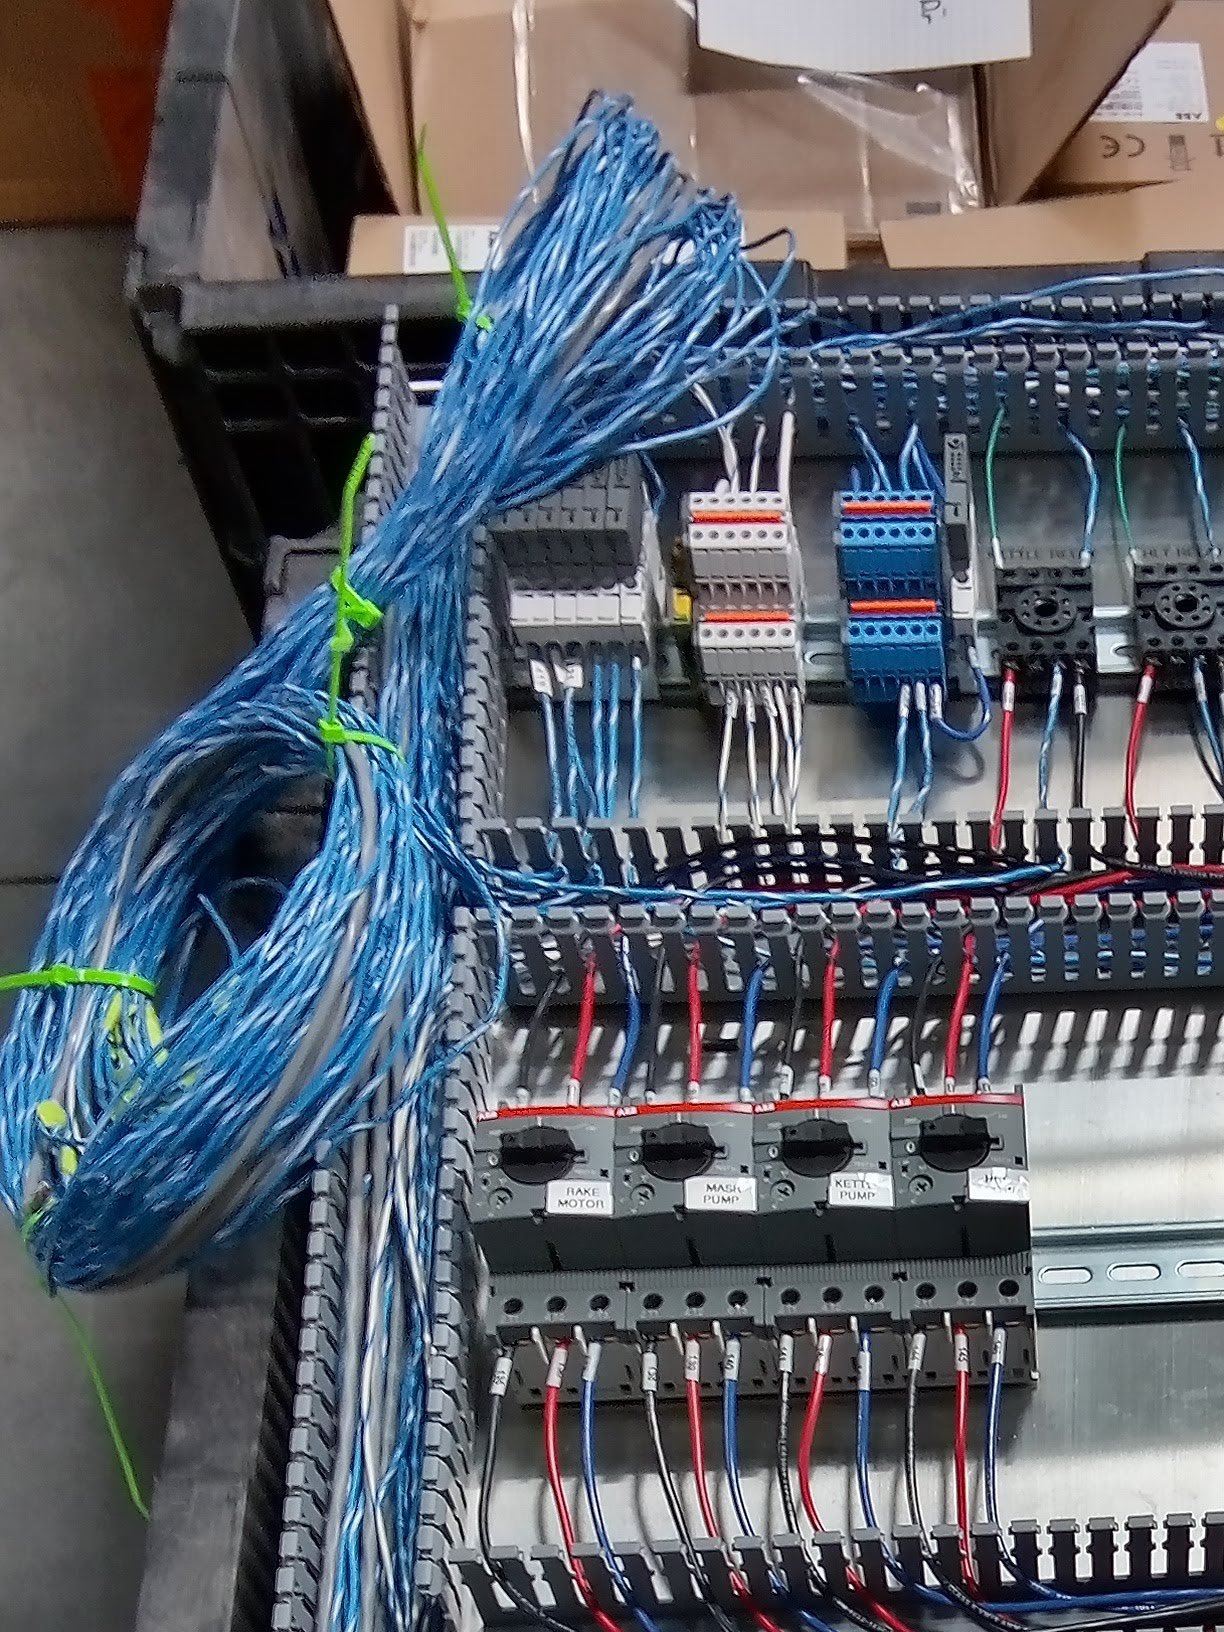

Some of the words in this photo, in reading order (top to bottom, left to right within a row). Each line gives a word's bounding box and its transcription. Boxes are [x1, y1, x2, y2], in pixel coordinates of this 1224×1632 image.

[567, 1187, 600, 1197] RAKE
[840, 1190, 875, 1200] PUMP
[558, 1199, 605, 1209] MOTOR
[703, 1194, 740, 1204] PUMP
